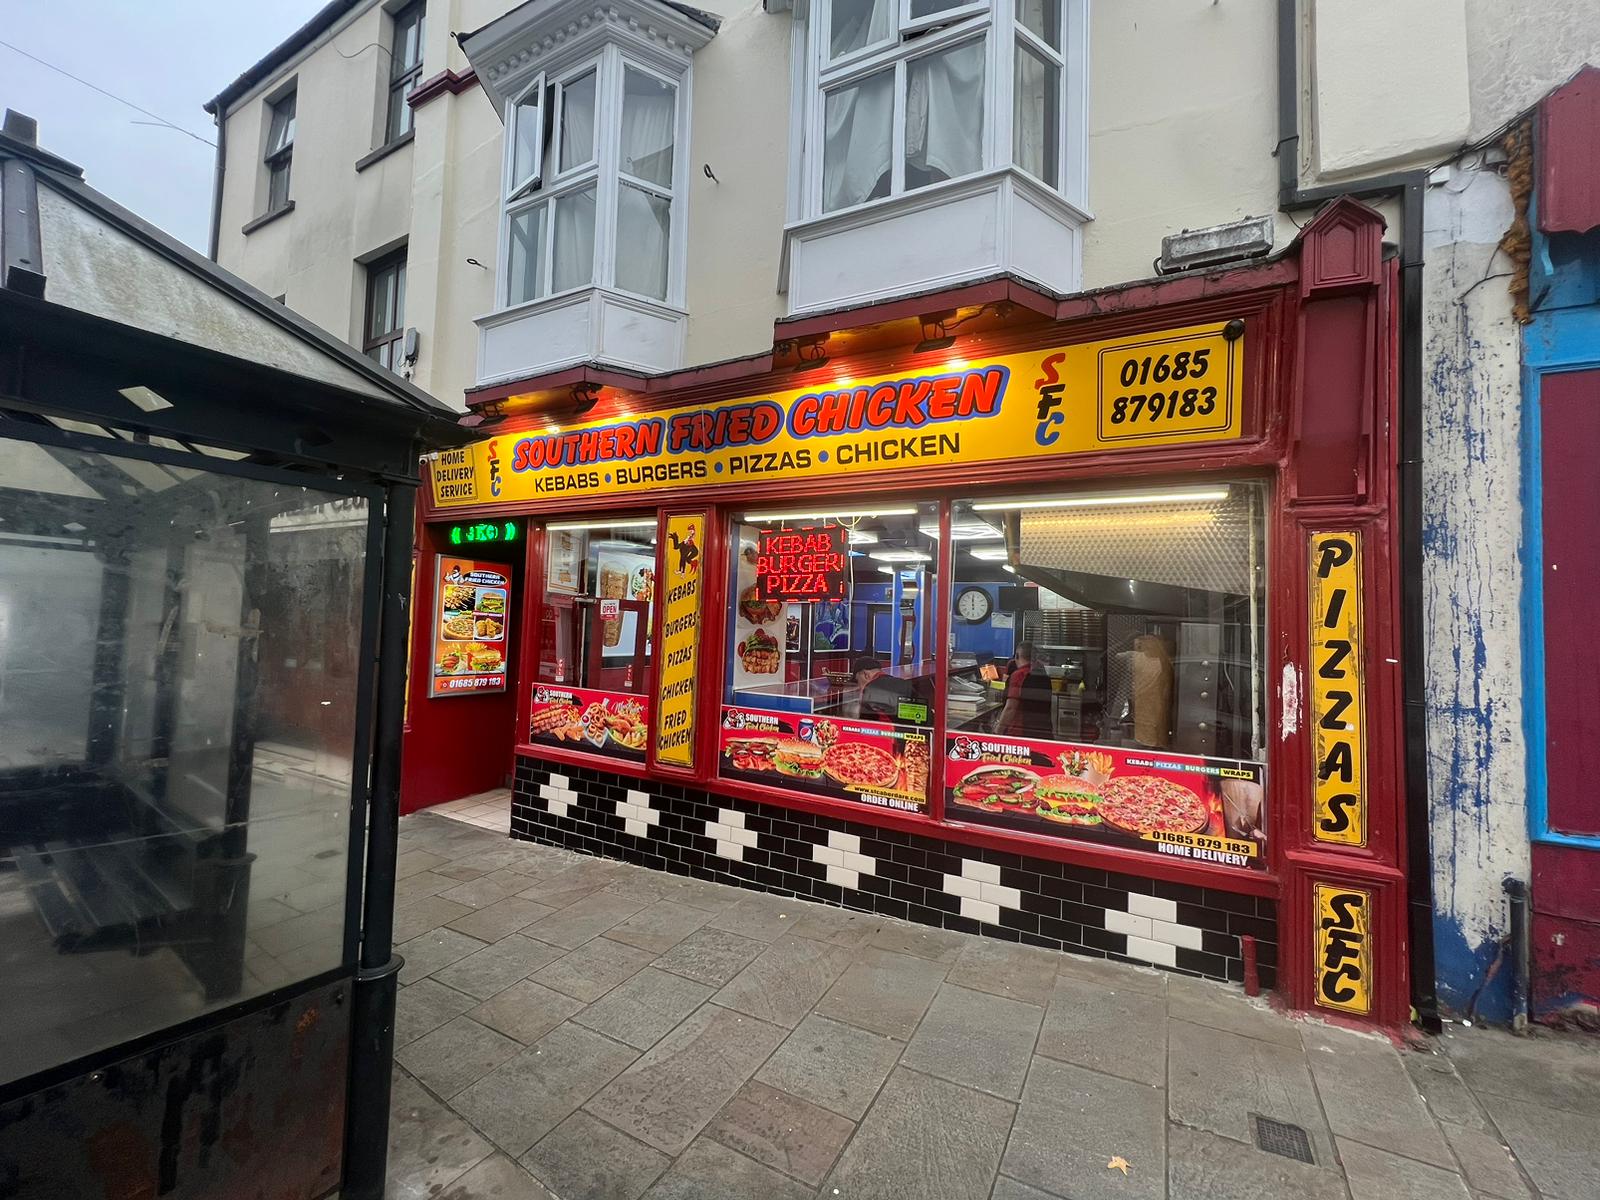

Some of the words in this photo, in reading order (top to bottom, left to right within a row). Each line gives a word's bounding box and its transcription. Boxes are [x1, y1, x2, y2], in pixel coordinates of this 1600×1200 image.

[1120, 348, 1211, 388] 01685
[1034, 352, 1068, 446] SFC
[1111, 386, 1217, 424] 879183
[513, 420, 663, 472] SOUTHERN
[670, 403, 782, 451] FRIED
[790, 368, 1003, 436] CHICKEN
[441, 451, 465, 465] HOME
[488, 440, 502, 496] SFC
[535, 472, 599, 493] KEBABS
[616, 459, 708, 485] BURGERS
[729, 448, 811, 475] PIZZAS
[836, 432, 960, 466] CHICKEN
[436, 466, 474, 482] DELIVERY
[440, 483, 473, 498] SERVICE
[766, 533, 832, 554] KEBAB
[757, 552, 841, 574] BURGER
[469, 572, 501, 580] SOUTHERN
[767, 573, 829, 593] PIZZA
[667, 579, 697, 604] KEBABS
[602, 605, 617, 613] OPEN
[665, 611, 697, 638] BURGERS
[667, 645, 693, 668] PIZZAS
[449, 679, 473, 688] 01685
[474, 678, 487, 687] 879
[488, 677, 501, 686] 183
[662, 677, 695, 700] CHICKEN
[1316, 538, 1357, 834] PIZZAS
[550, 690, 573, 699] SOUTHERN
[664, 709, 687, 730] FRIED
[745, 713, 779, 725] SOUTHERN
[659, 728, 692, 750] CHICKEN
[981, 742, 1030, 756] SOUTHERN
[981, 753, 1001, 763] Fried
[1002, 754, 1032, 765] Chicken
[1126, 758, 1154, 767] KEBABS
[1155, 761, 1182, 770] PIZZAS
[1185, 764, 1220, 775] BURGERS
[1223, 769, 1251, 778] WRAPS
[861, 793, 888, 806] ORDER
[888, 798, 919, 812] ONLINE
[1152, 830, 1194, 845] 01685
[1197, 837, 1222, 849] 879
[1225, 842, 1250, 854] 183
[1158, 842, 1191, 857] HOME
[1193, 847, 1248, 867] DELIVERY
[1321, 893, 1364, 1003] SFC
